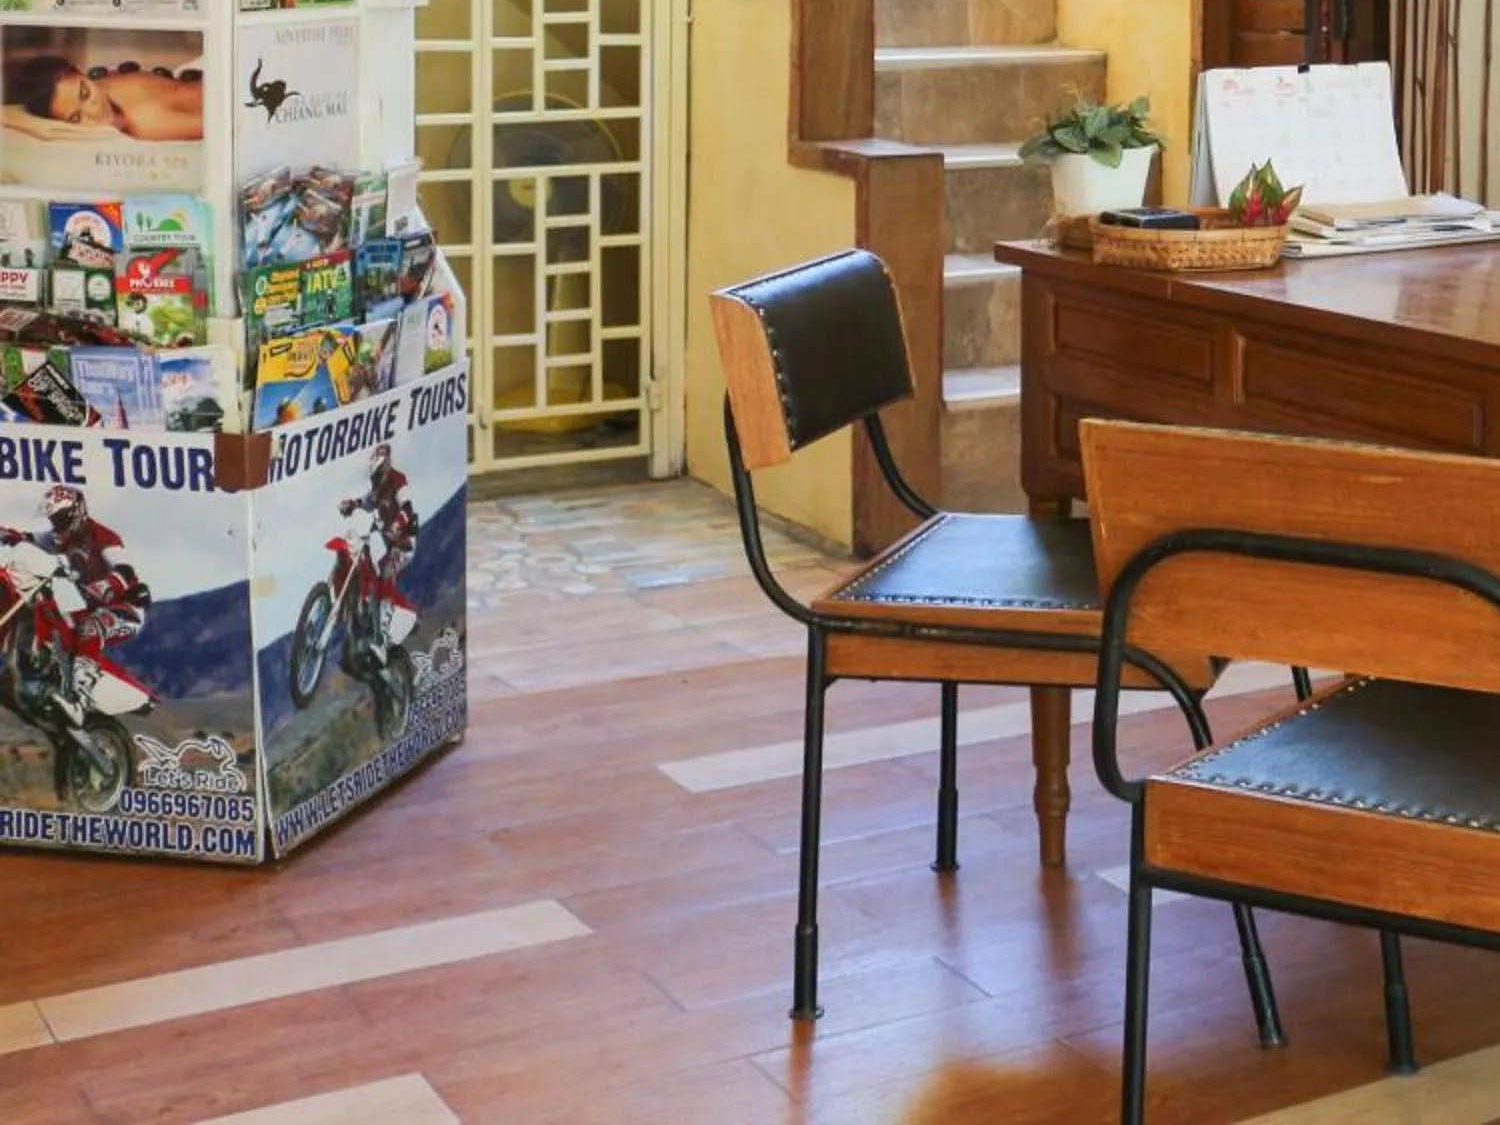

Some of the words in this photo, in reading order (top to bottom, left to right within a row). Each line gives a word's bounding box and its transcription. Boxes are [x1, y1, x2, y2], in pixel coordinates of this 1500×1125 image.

[408, 372, 467, 431] TOURS
[0, 436, 87, 485] BIKE
[103, 438, 215, 492] TOUR
[144, 764, 193, 787] Let's
[198, 769, 244, 792] Ride
[119, 788, 255, 823] 0966967085
[0, 809, 256, 857] RIDETHEWORLD.COM
